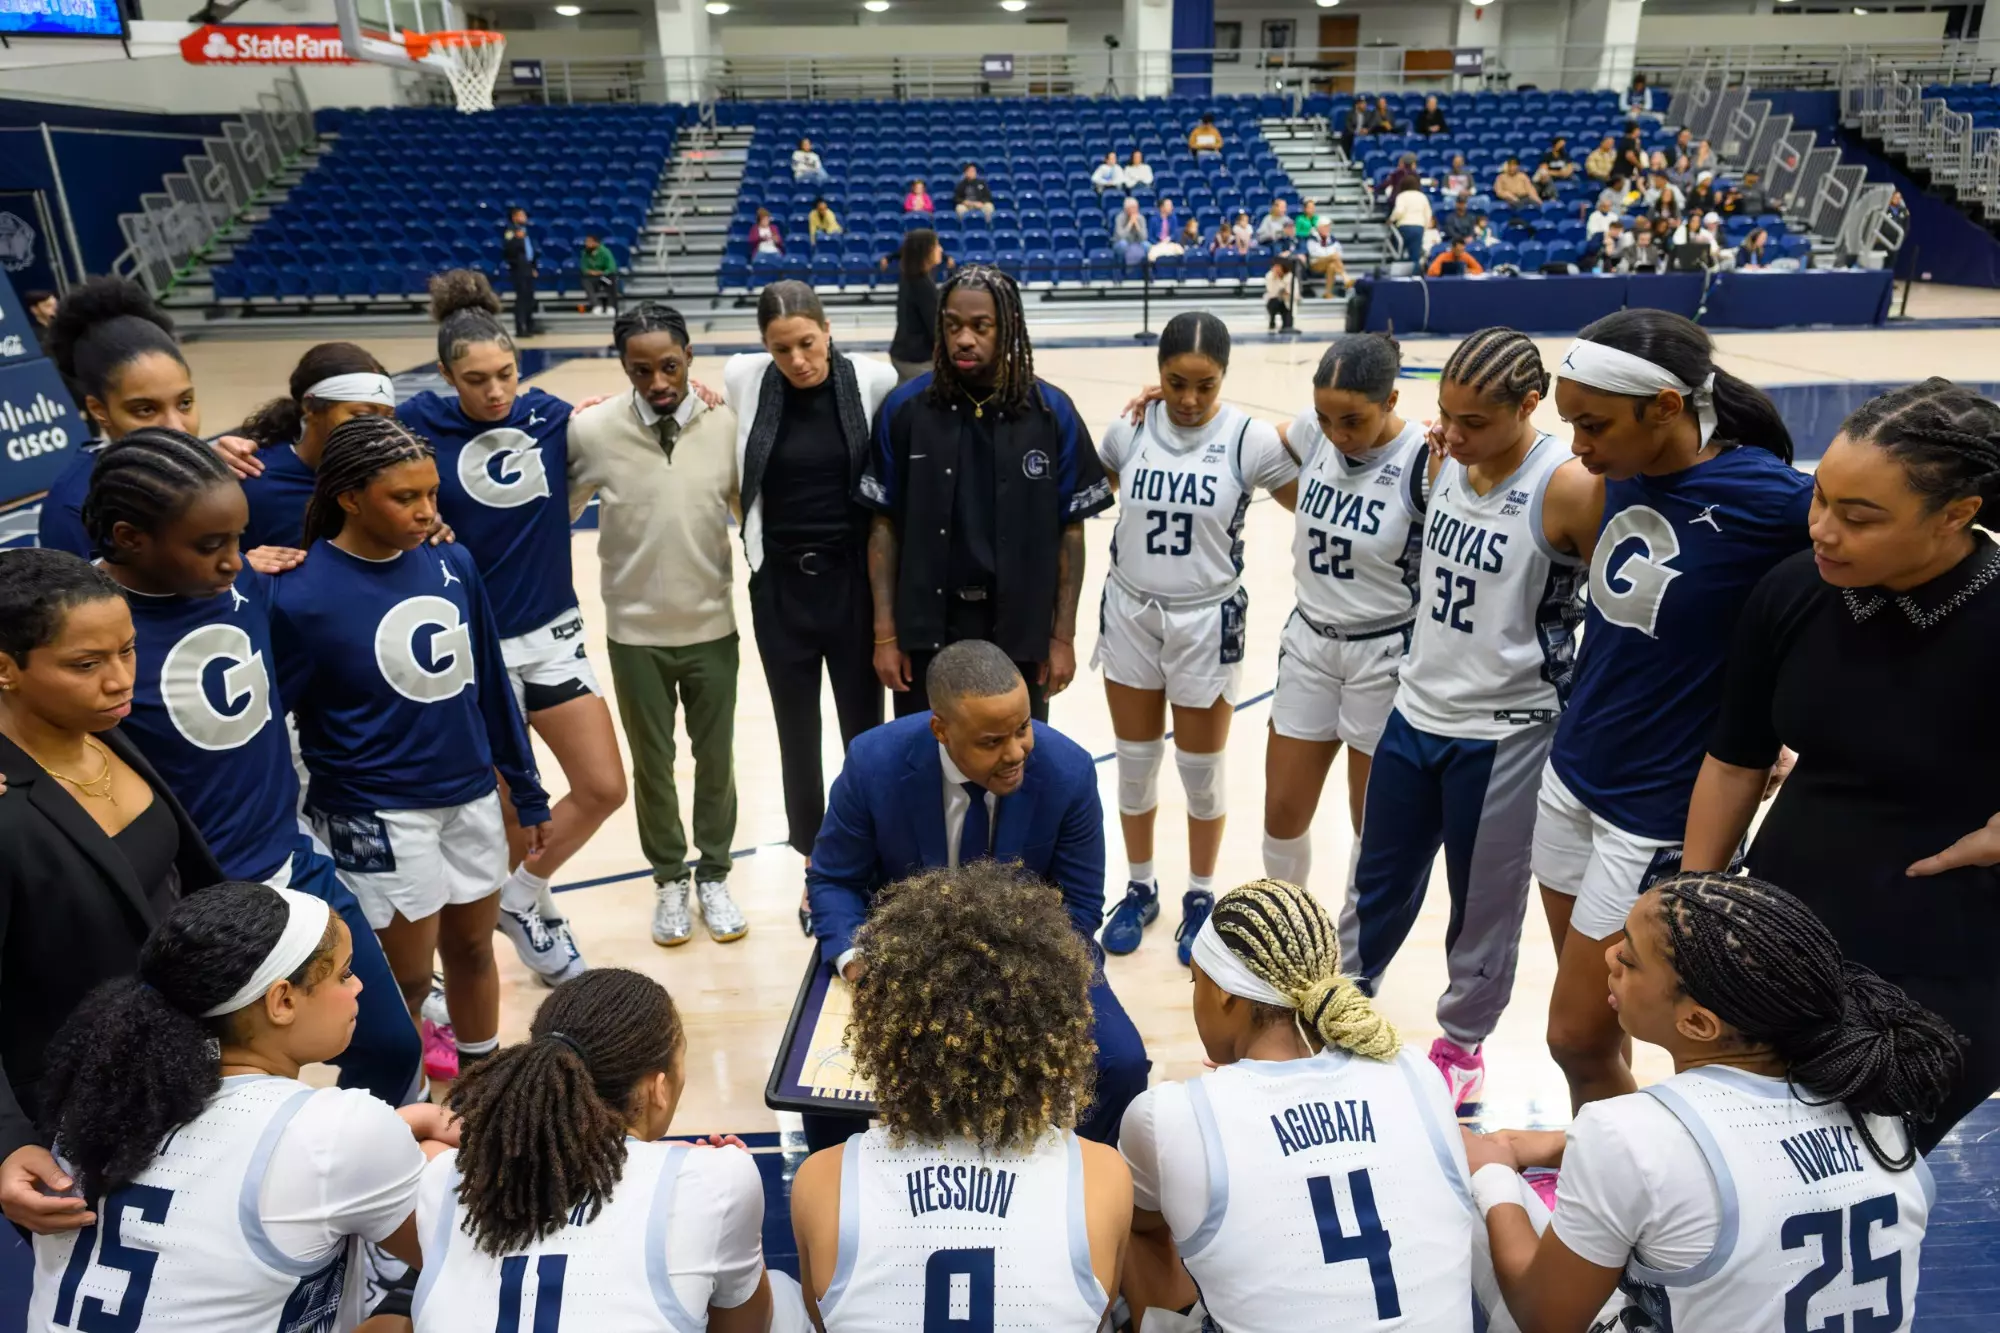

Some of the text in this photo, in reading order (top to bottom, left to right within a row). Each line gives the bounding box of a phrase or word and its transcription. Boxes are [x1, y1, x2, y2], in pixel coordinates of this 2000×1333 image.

[7, 426, 68, 462] CISCO
[457, 427, 551, 508] G
[1131, 468, 1218, 507] HOYAS
[1299, 478, 1386, 535] HOYAS
[1146, 509, 1193, 556] 23
[1308, 527, 1354, 580] 22
[1426, 509, 1508, 574] HOYAS
[1431, 566, 1476, 634] 32
[1589, 504, 1684, 640] G
[374, 595, 475, 703] G
[160, 623, 272, 751] G
[1270, 1100, 1376, 1157] AGUBATA
[1780, 1125, 1864, 1184] NWEKE
[906, 1164, 1016, 1218] HESSION
[52, 1182, 175, 1333] 15
[1306, 1168, 1402, 1320] 4
[1781, 1192, 1904, 1333] 25
[495, 1254, 568, 1333] 11
